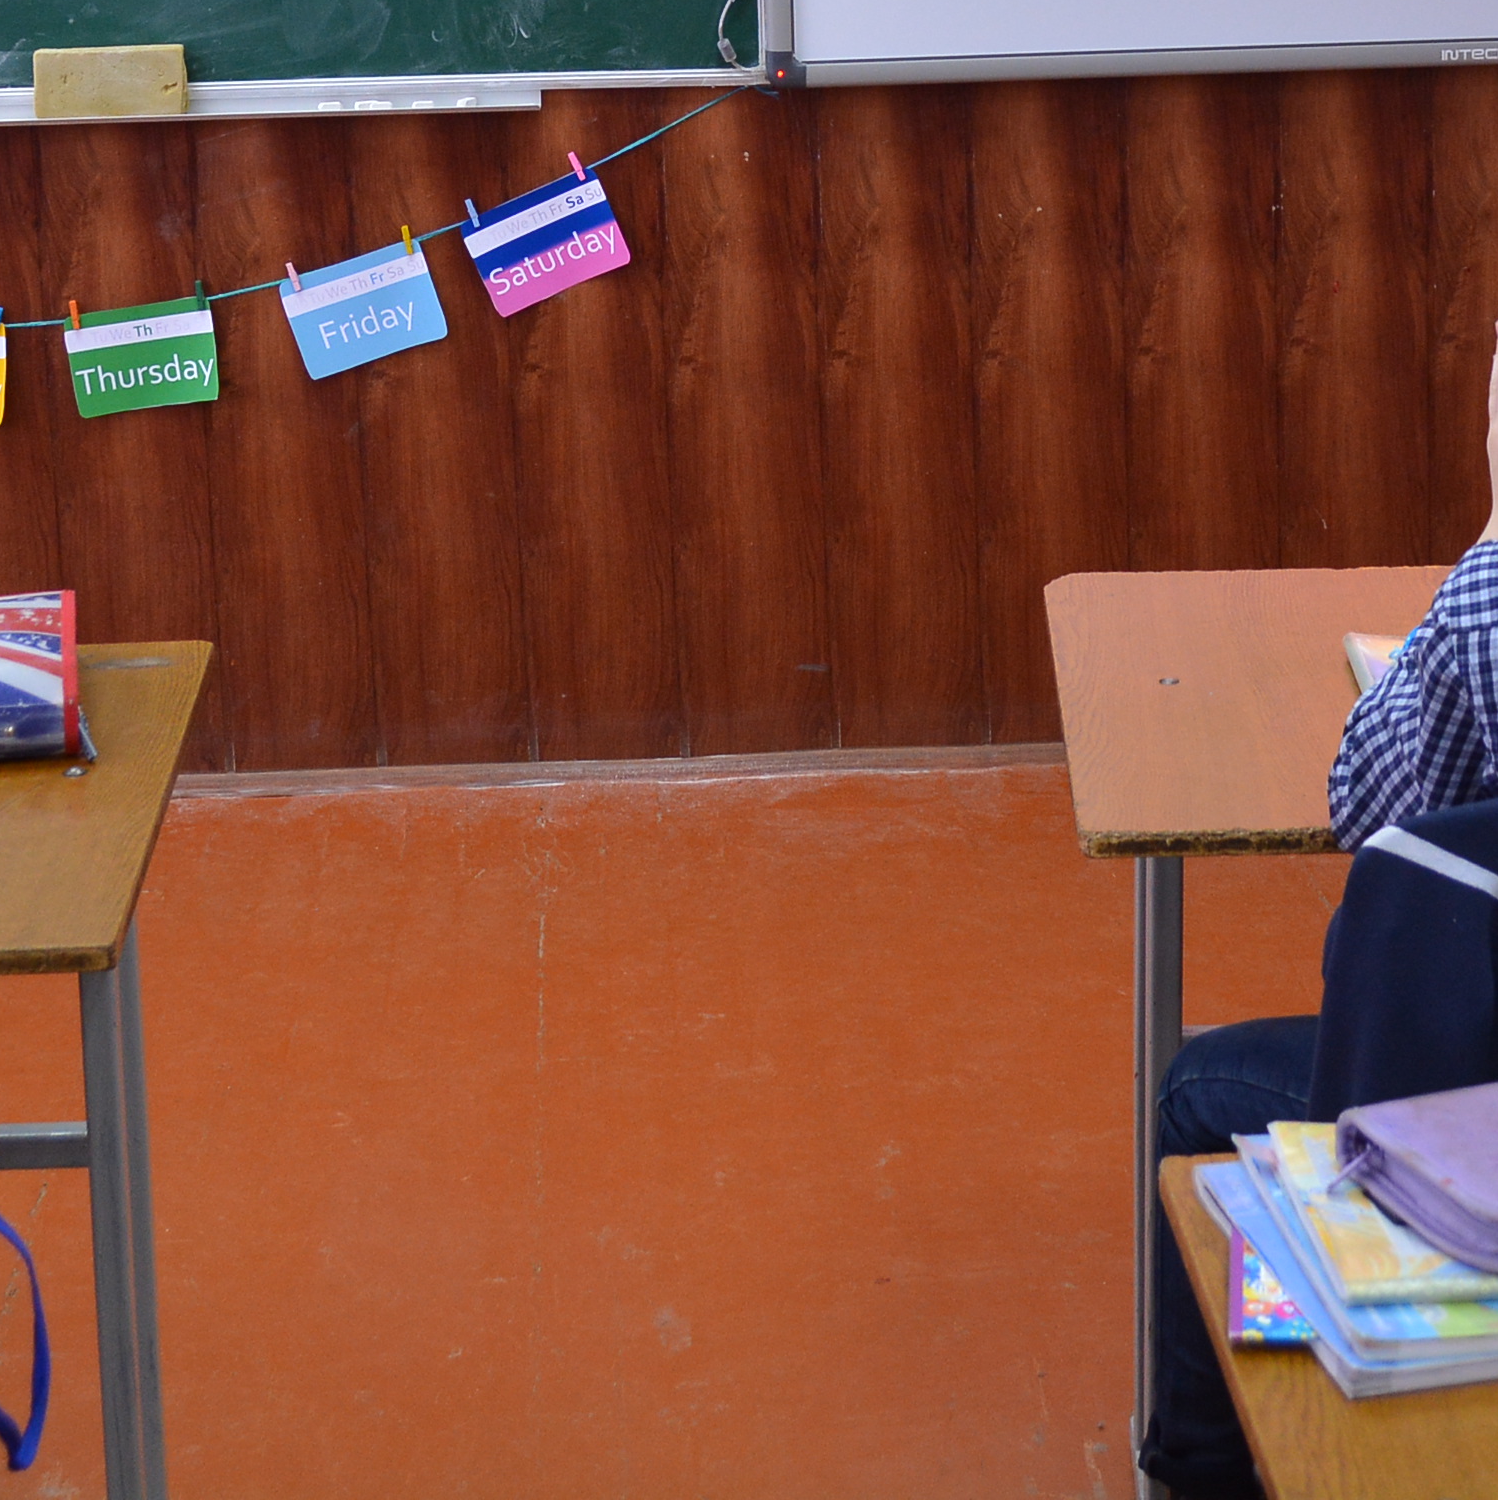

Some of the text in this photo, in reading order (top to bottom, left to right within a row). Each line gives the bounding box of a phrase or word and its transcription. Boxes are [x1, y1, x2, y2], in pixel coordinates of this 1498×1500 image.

[565, 196, 585, 209] Sa
[489, 226, 615, 295] Saturday
[369, 272, 385, 285] Fr
[133, 325, 153, 337] Th
[318, 301, 413, 349] Friday
[75, 353, 214, 395] Thursday
